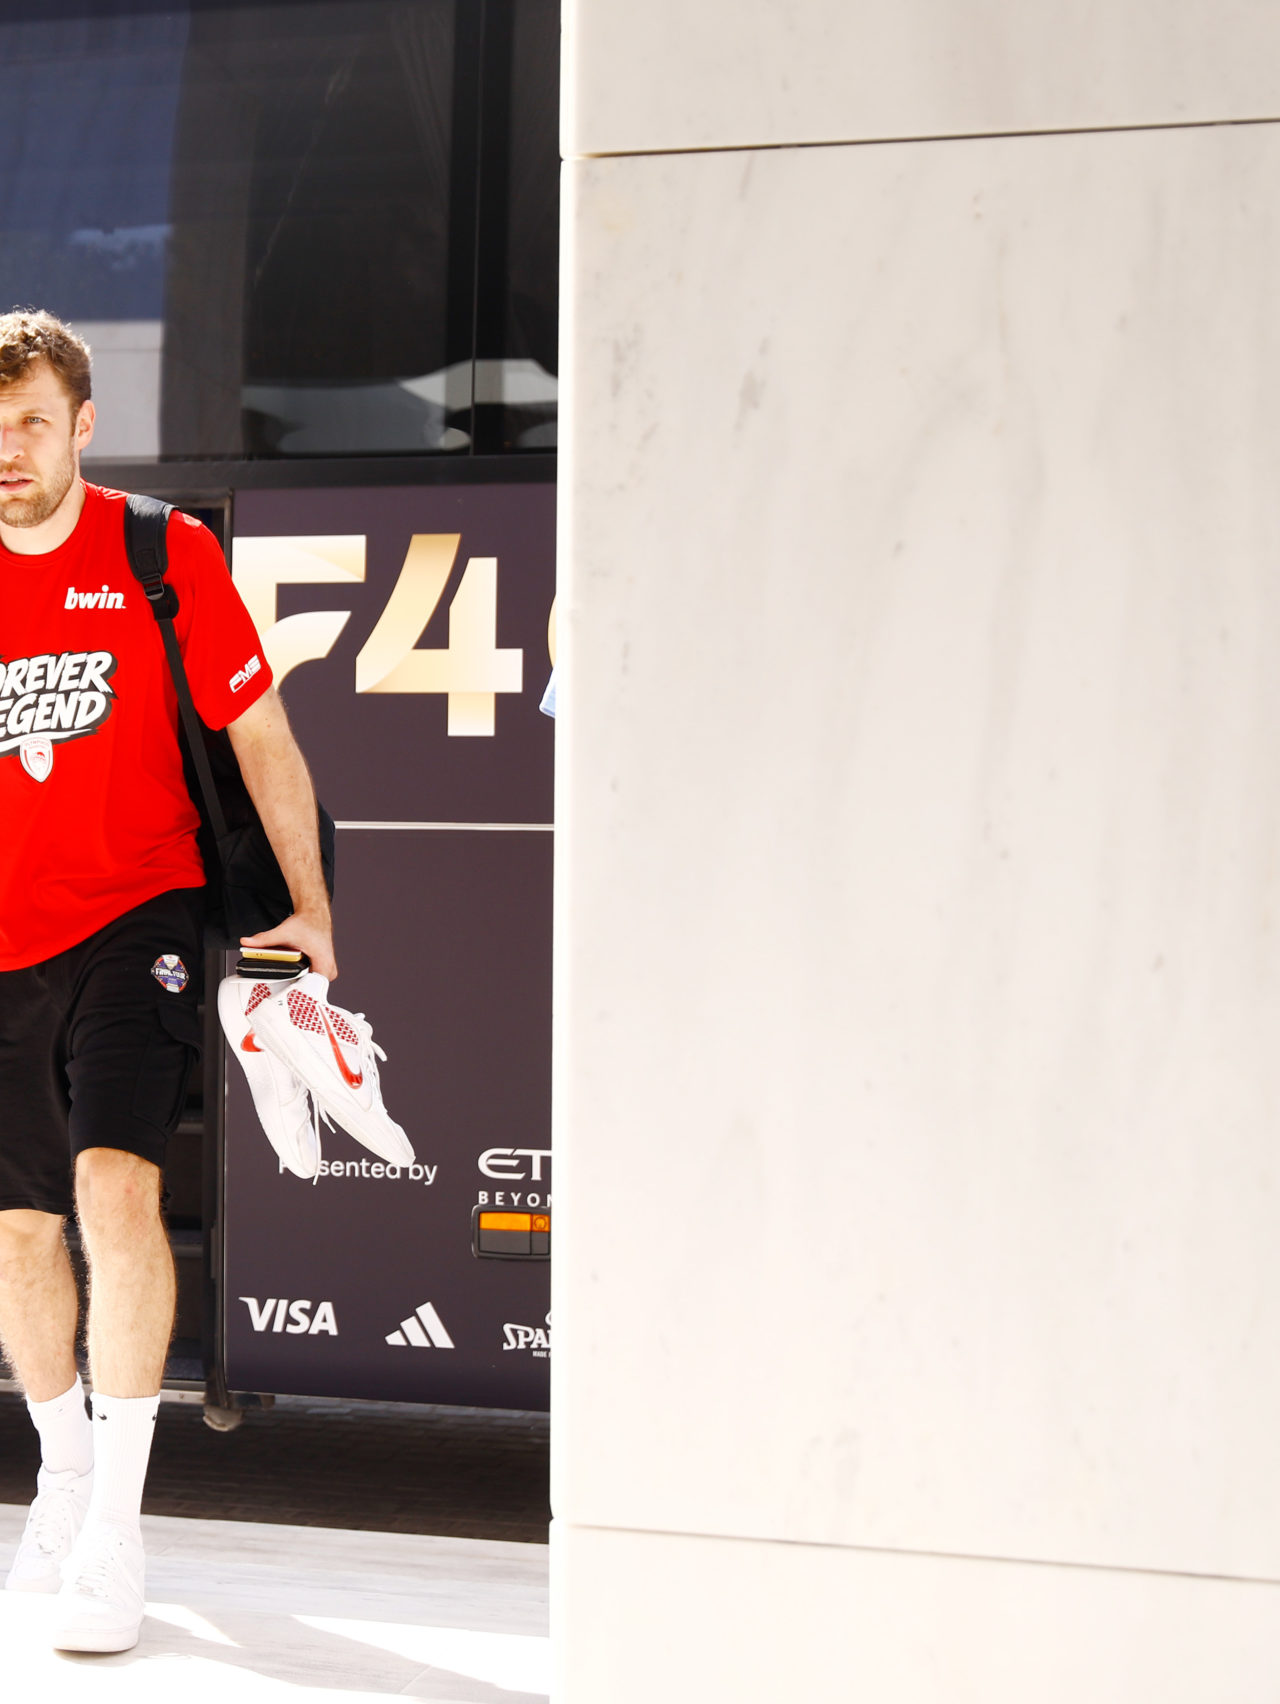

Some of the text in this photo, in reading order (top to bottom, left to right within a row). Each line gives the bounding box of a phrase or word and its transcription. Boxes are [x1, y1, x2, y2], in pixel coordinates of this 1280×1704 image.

[232, 533, 556, 736] F4
[278, 1156, 438, 1186] sented by
[238, 1297, 338, 1336] VISA
